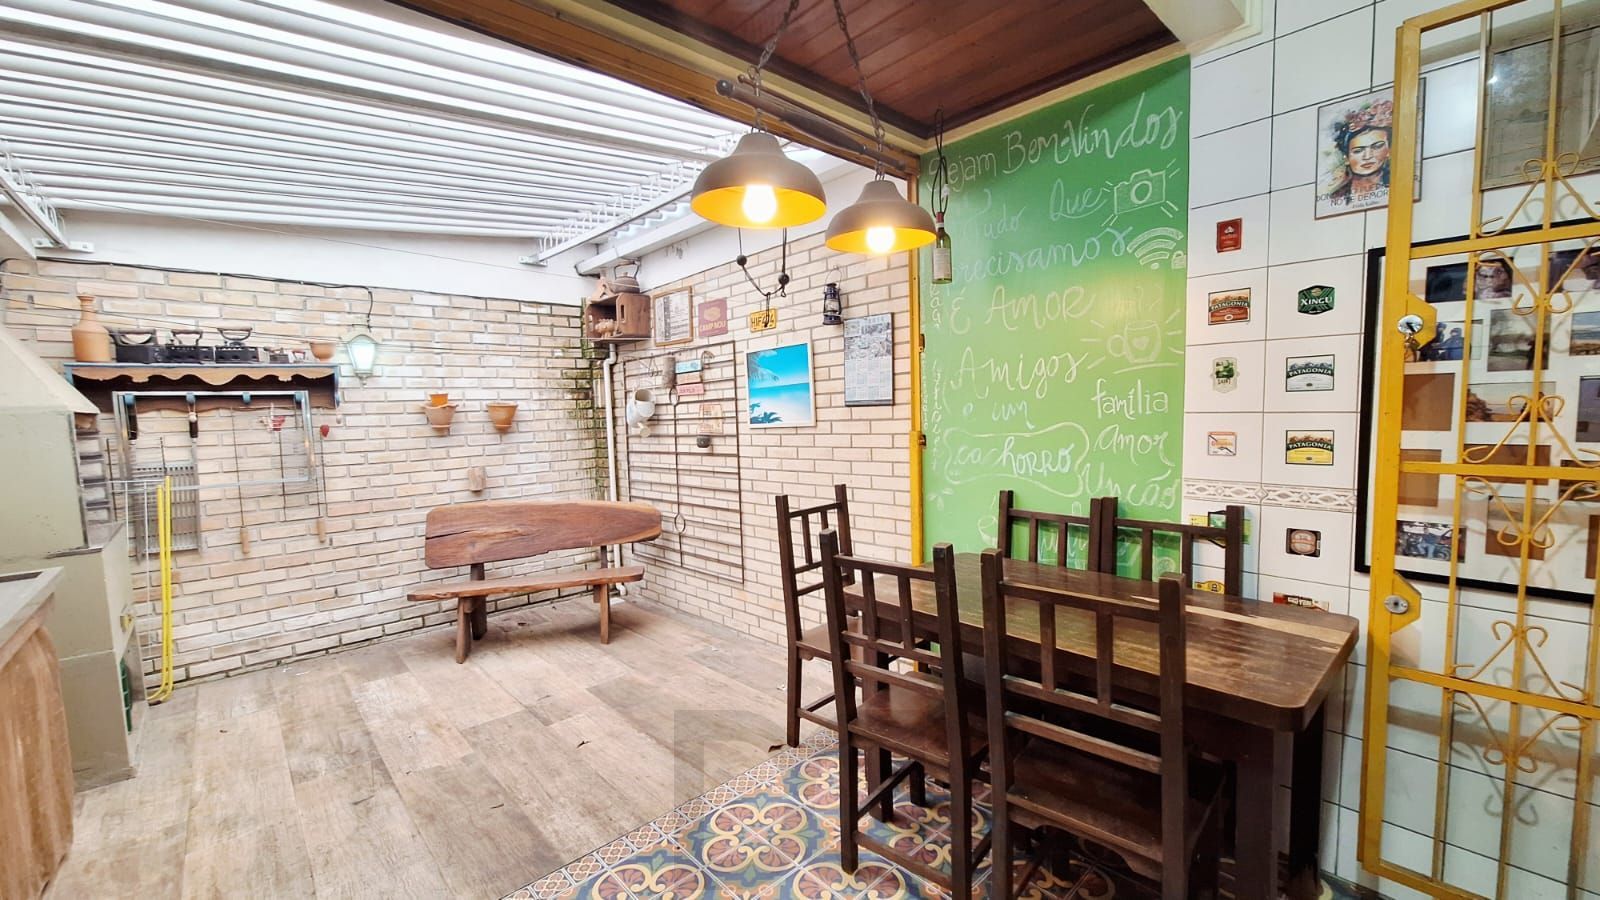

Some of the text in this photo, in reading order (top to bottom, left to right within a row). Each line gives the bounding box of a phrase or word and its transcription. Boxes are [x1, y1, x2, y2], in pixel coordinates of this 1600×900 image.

[1210, 301, 1249, 311] PATAGONIA
[1301, 296, 1333, 306] XINGU
[1288, 367, 1333, 377] PATAGONIA
[1288, 441, 1333, 451] PATAGONIA
